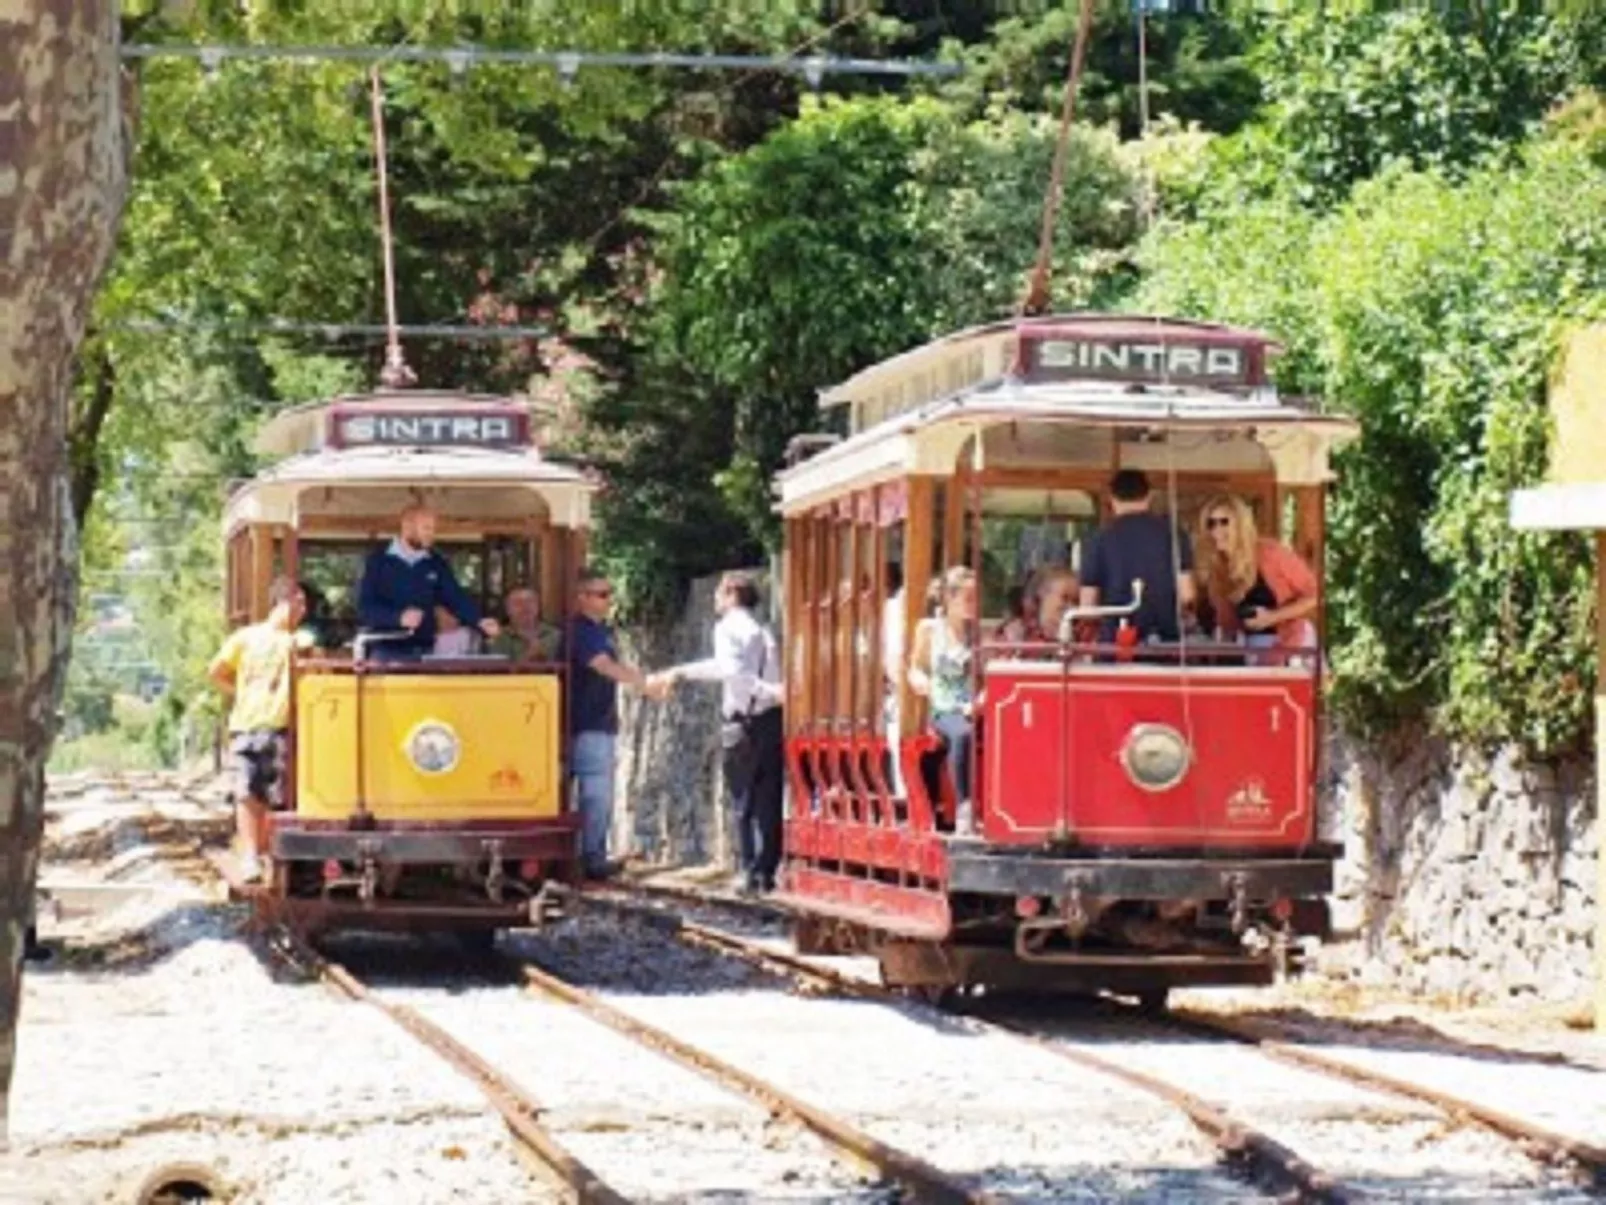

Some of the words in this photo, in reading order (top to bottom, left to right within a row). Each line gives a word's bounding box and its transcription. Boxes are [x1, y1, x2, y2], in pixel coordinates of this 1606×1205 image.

[1039, 340, 1241, 375] SINTRA
[344, 416, 509, 441] SINTRA
[522, 701, 538, 725] 7
[1022, 701, 1033, 729] 1
[1269, 705, 1280, 731] 1
